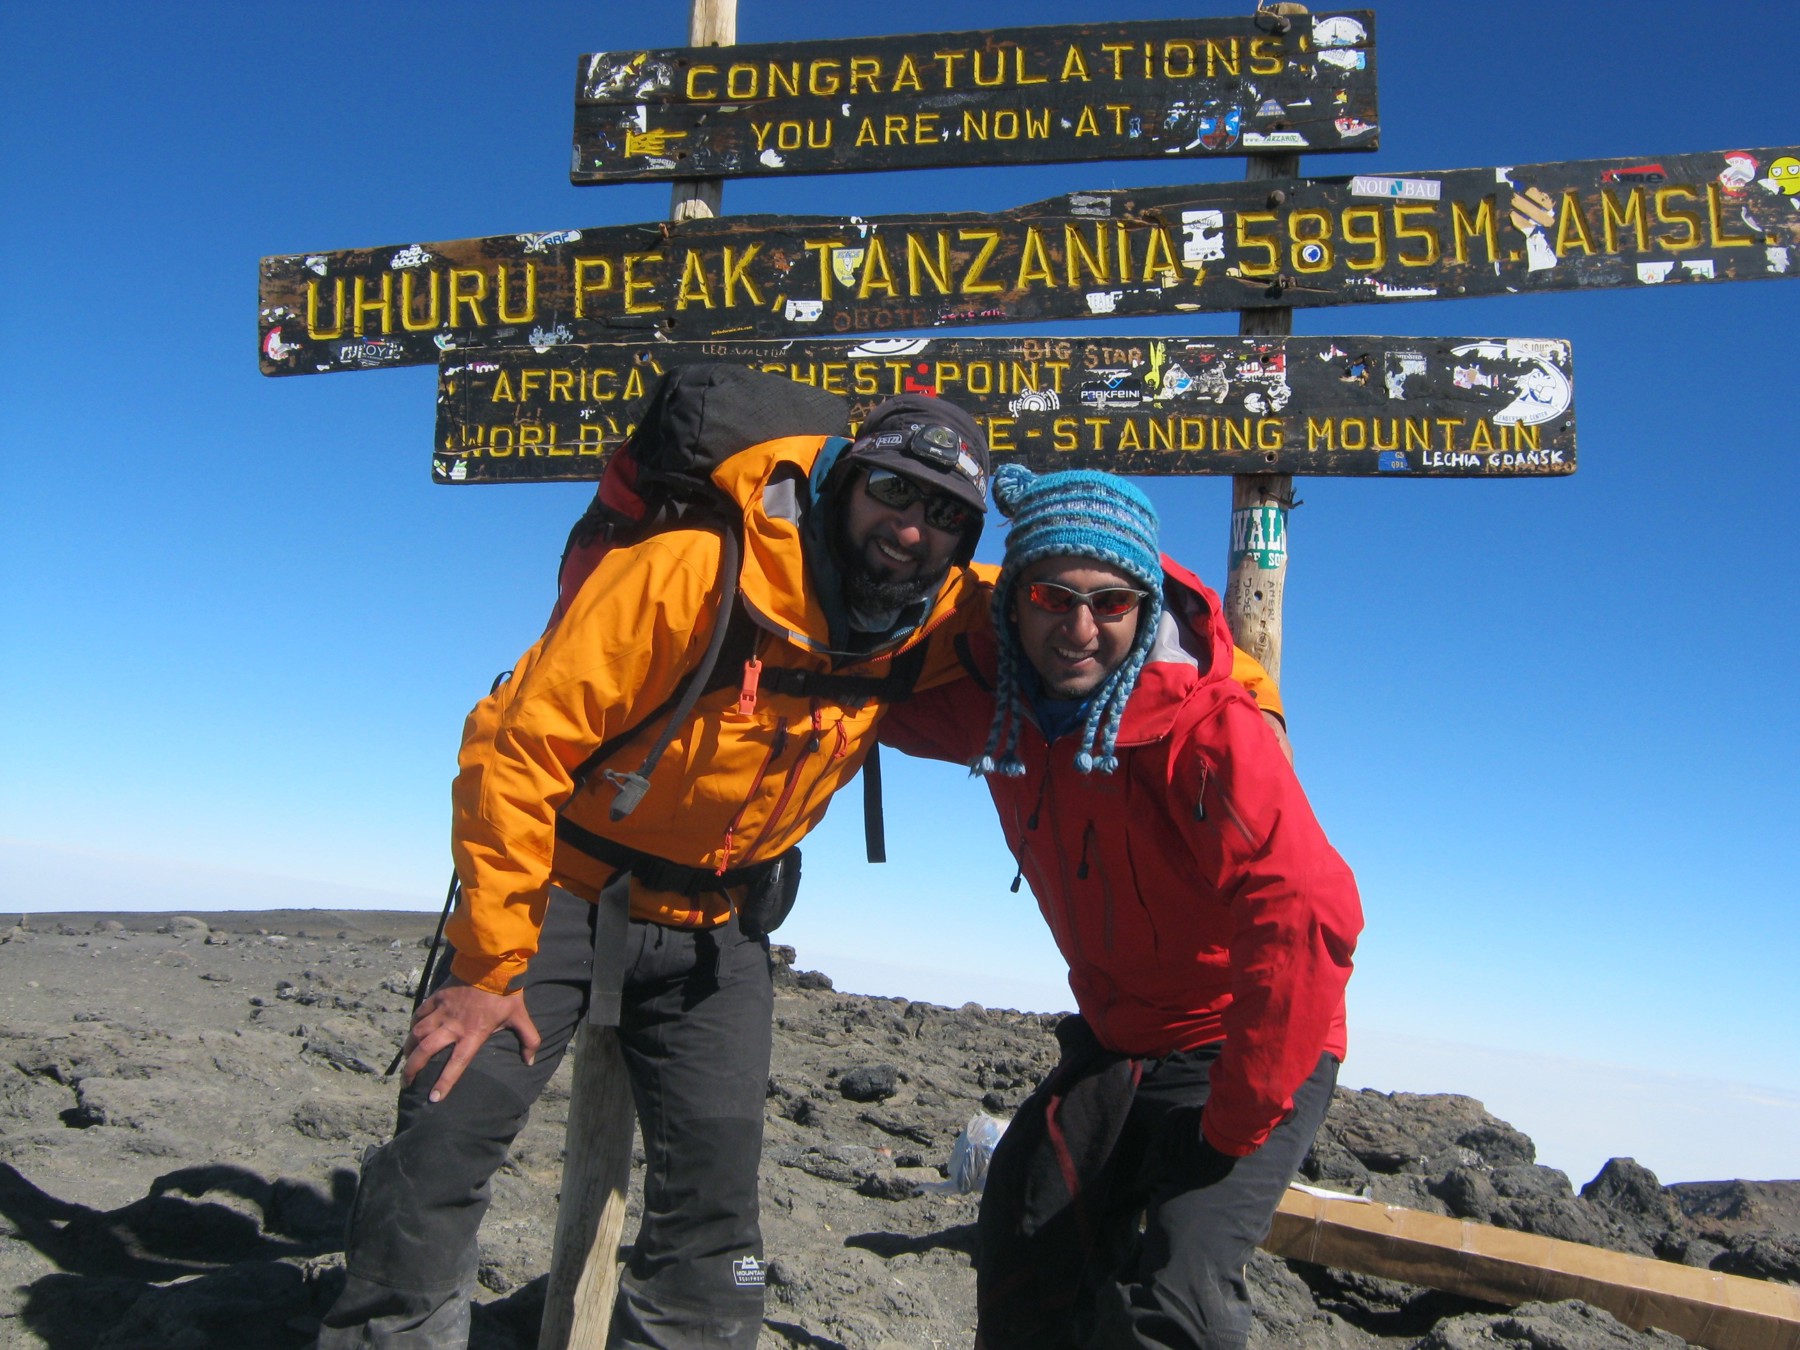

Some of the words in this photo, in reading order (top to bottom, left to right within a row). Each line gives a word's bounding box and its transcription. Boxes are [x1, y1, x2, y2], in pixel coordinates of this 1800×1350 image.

[684, 35, 1309, 101] CONGRATULATIONS!
[750, 119, 833, 151] YOU
[855, 113, 942, 148] ARE
[963, 109, 1053, 143] NOW
[1075, 104, 1132, 138] AT
[1405, 183, 1438, 198] BAU
[305, 261, 537, 342] UHURU
[573, 244, 788, 321] PEAK,
[804, 219, 1208, 304] TANZANIA,
[1554, 181, 1779, 258] AMSL.
[1023, 338, 1073, 361] BIG
[1083, 343, 1143, 370] STAR
[491, 359, 662, 402] AFRICA'
[935, 359, 1072, 396] POINT
[460, 414, 638, 459] WORLD'
[1306, 417, 1543, 452] MOUNTAIN
[1422, 451, 1481, 467] LECHIA
